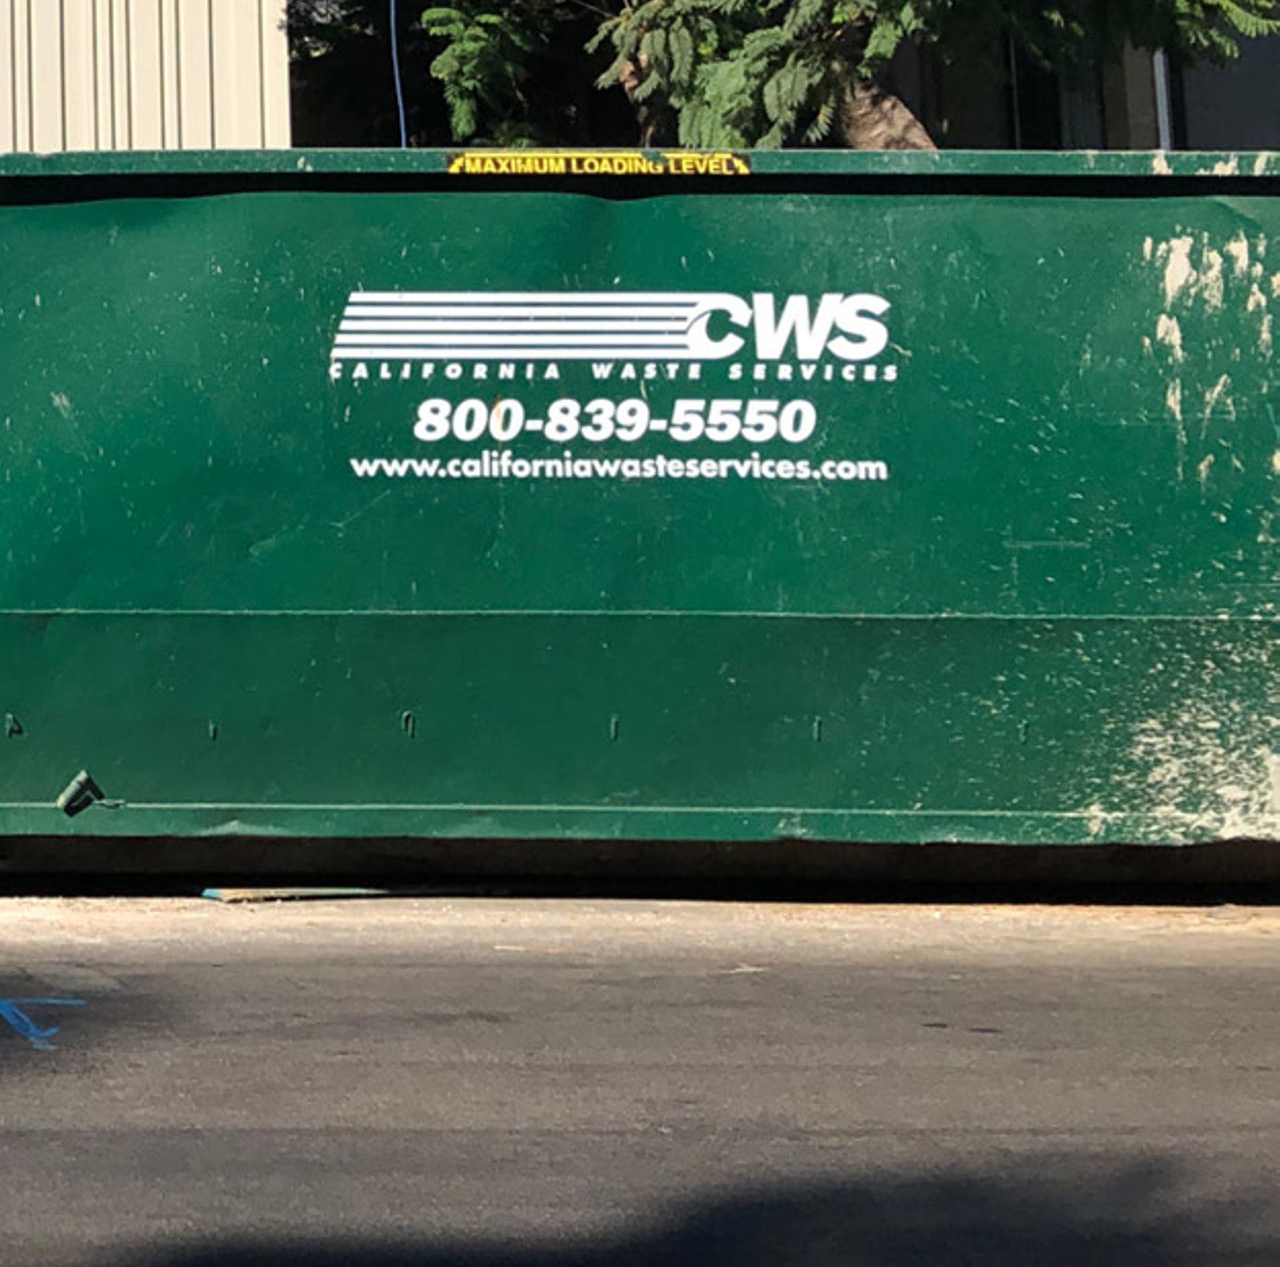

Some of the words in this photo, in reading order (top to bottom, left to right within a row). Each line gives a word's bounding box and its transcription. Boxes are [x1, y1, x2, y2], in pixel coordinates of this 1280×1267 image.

[464, 157, 566, 174] MAXIMUM
[571, 157, 664, 174] LOADING
[669, 157, 735, 174] LEVEL
[686, 292, 891, 360] CWS
[328, 362, 560, 380] CALIFORNIA
[591, 362, 701, 380] WASTE
[728, 363, 898, 381] SERVICES
[413, 398, 816, 442] 800-839-5550
[350, 450, 888, 480] www.californiawasteservices.com
